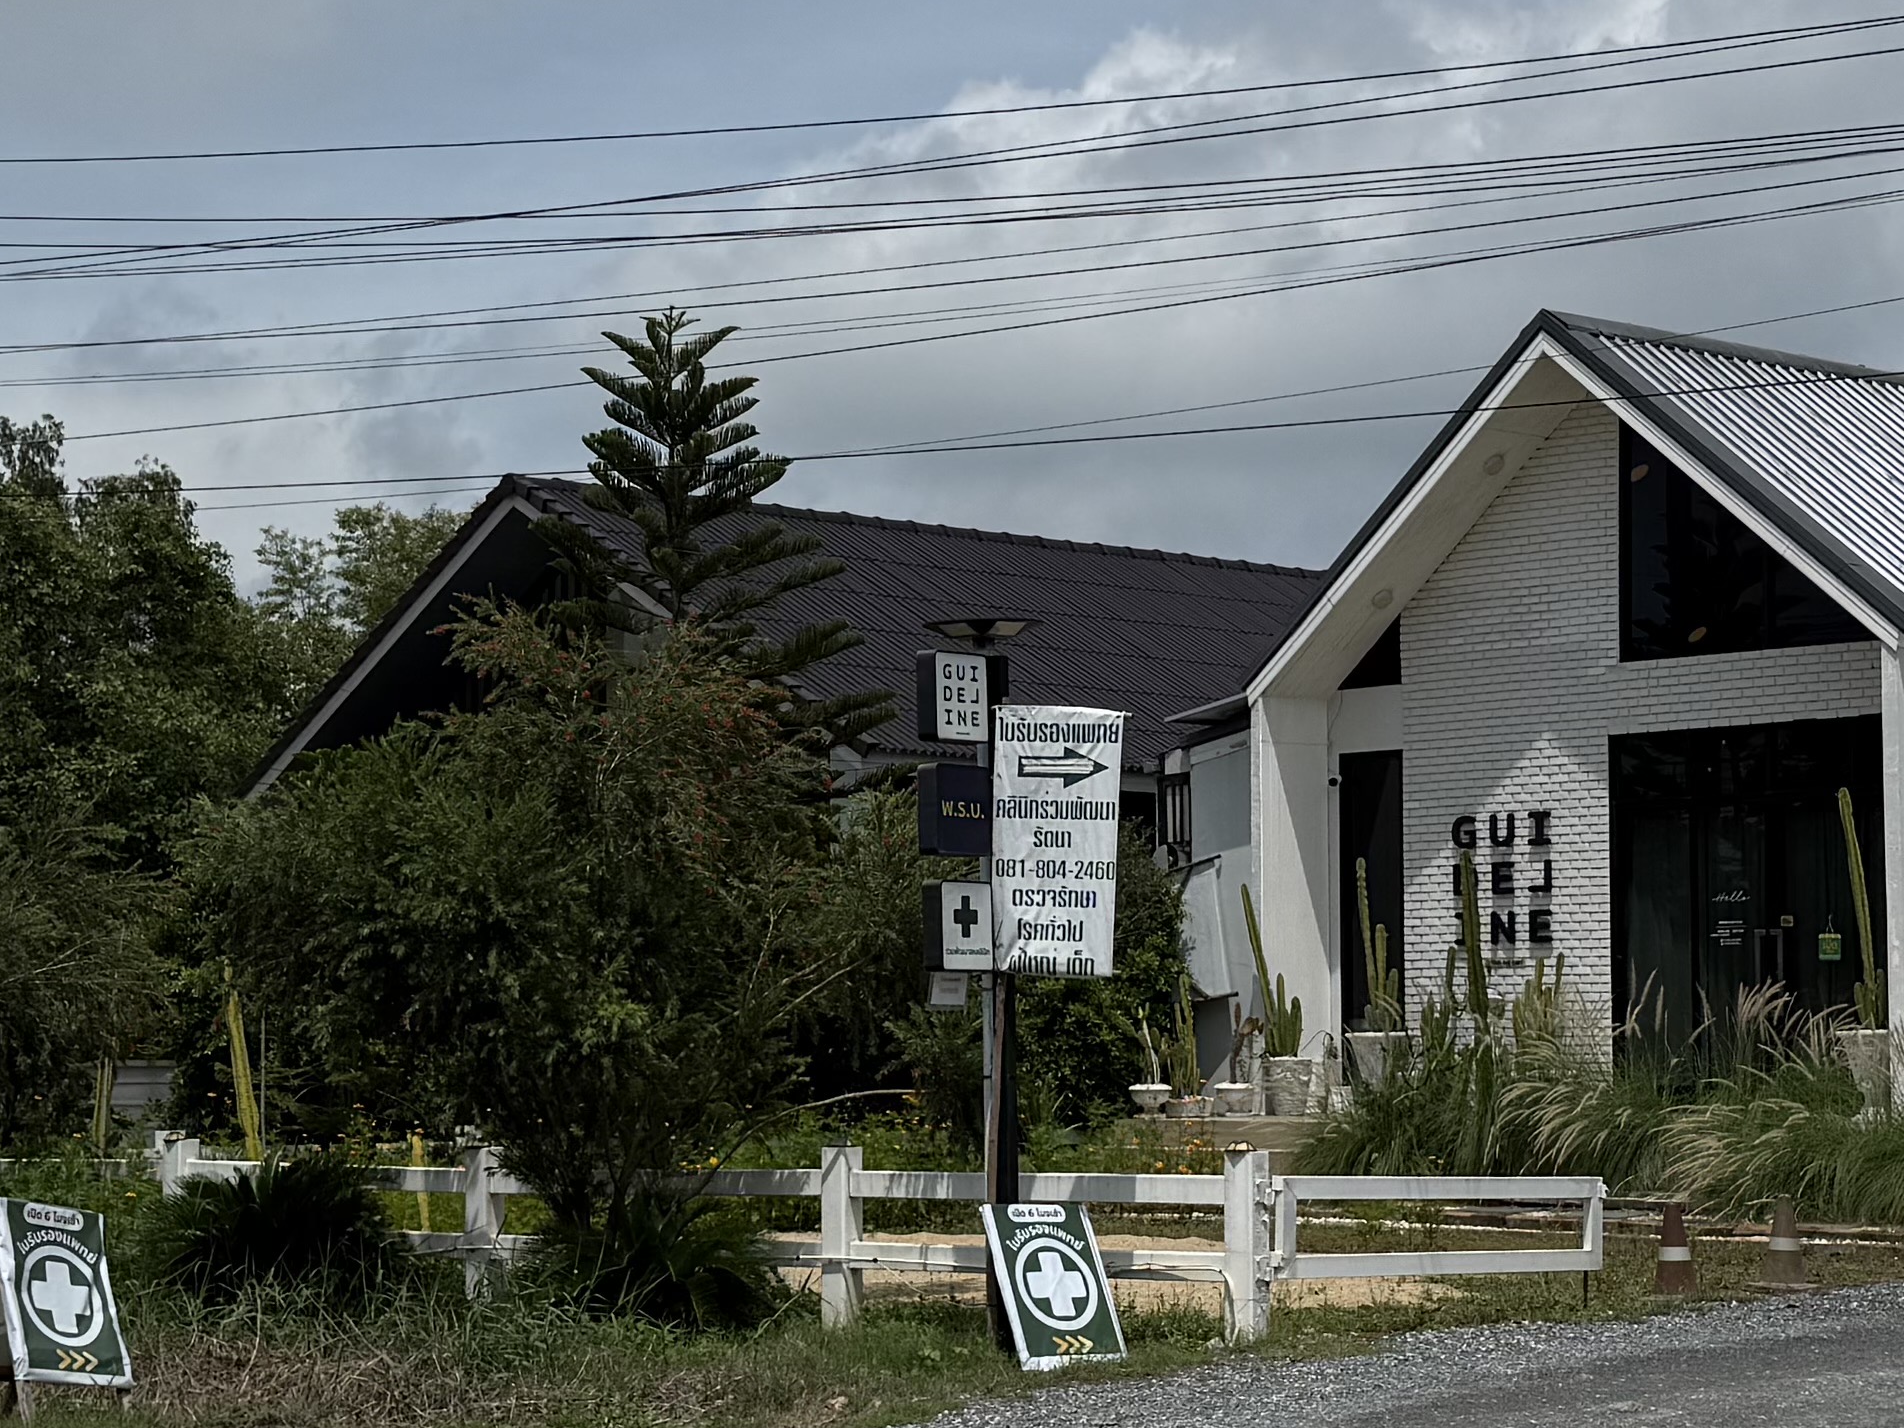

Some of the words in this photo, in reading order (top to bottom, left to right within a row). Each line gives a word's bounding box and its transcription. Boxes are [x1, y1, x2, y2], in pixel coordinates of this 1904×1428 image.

[942, 663, 979, 682] GUI
[944, 708, 981, 727] INE
[941, 799, 985, 819] W.S.U.
[995, 790, 1116, 821] คลินิกร่วมพัฒนา
[1033, 825, 1072, 848] รัตนา
[1452, 811, 1552, 849] GUI
[995, 858, 1115, 880] 081-804-2460
[1011, 885, 1097, 909] ตรวจรักษา
[1017, 915, 1084, 942] โรคทั่วไป
[1028, 1208, 1035, 1218] 6
